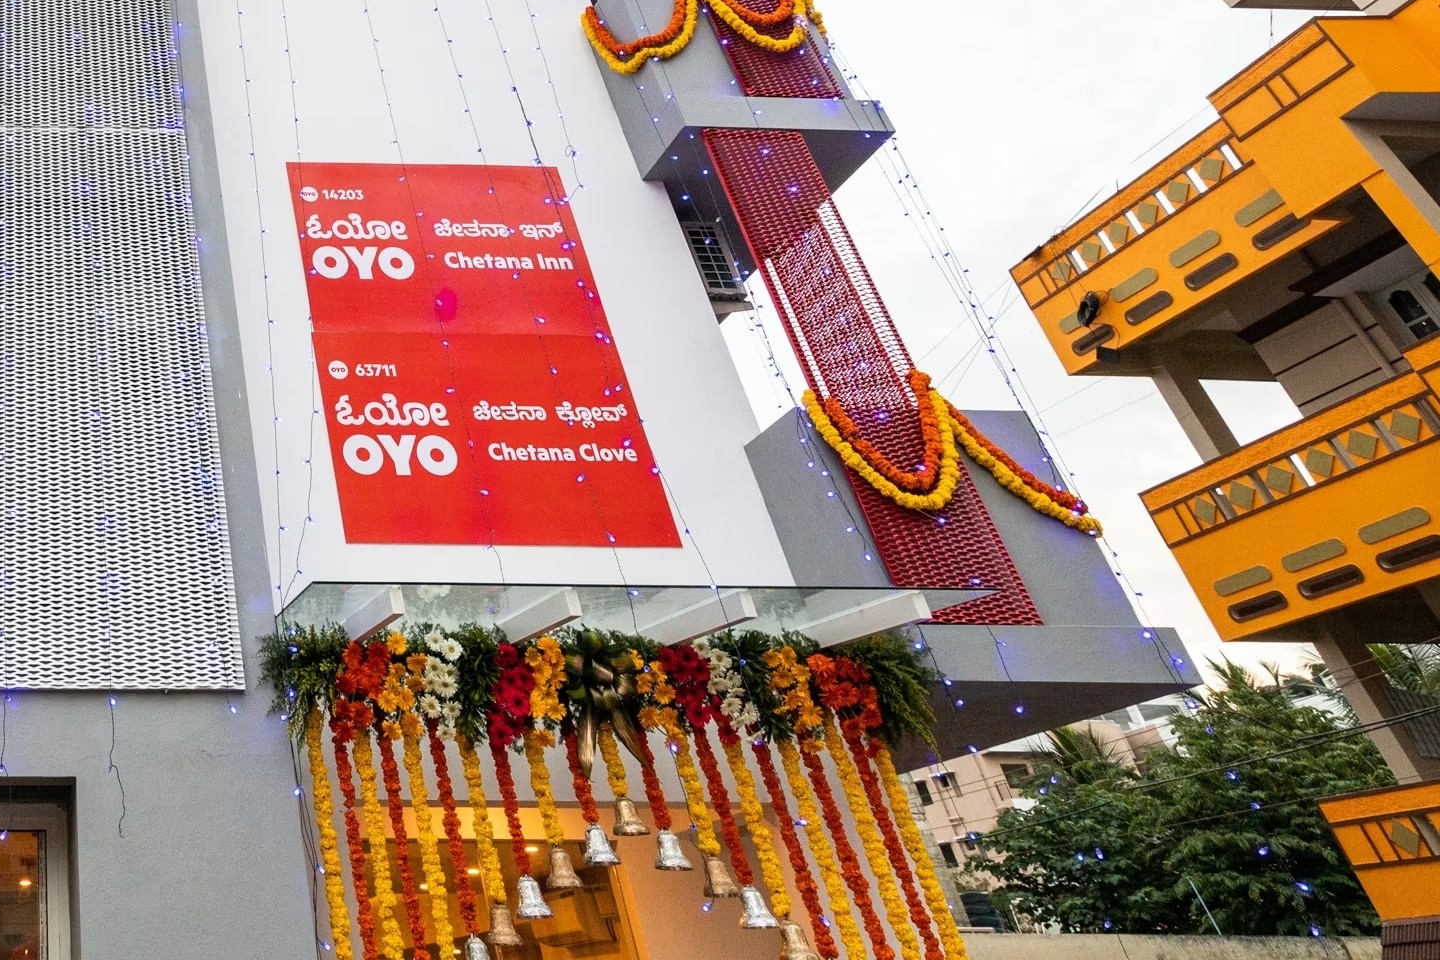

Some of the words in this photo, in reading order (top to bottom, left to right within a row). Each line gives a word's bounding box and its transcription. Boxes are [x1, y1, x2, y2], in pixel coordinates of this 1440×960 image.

[321, 188, 364, 200] 14203
[306, 212, 409, 240] ಓಯೋ
[519, 221, 564, 240] ಇನ್
[312, 245, 415, 280] OYO
[444, 251, 534, 270] Chetana
[536, 253, 574, 270] Inn
[355, 363, 397, 377] 63711
[335, 393, 450, 426] ಓಯೋ
[342, 433, 458, 476] OYO
[488, 442, 576, 462] Chetana
[579, 443, 638, 462] Clove
